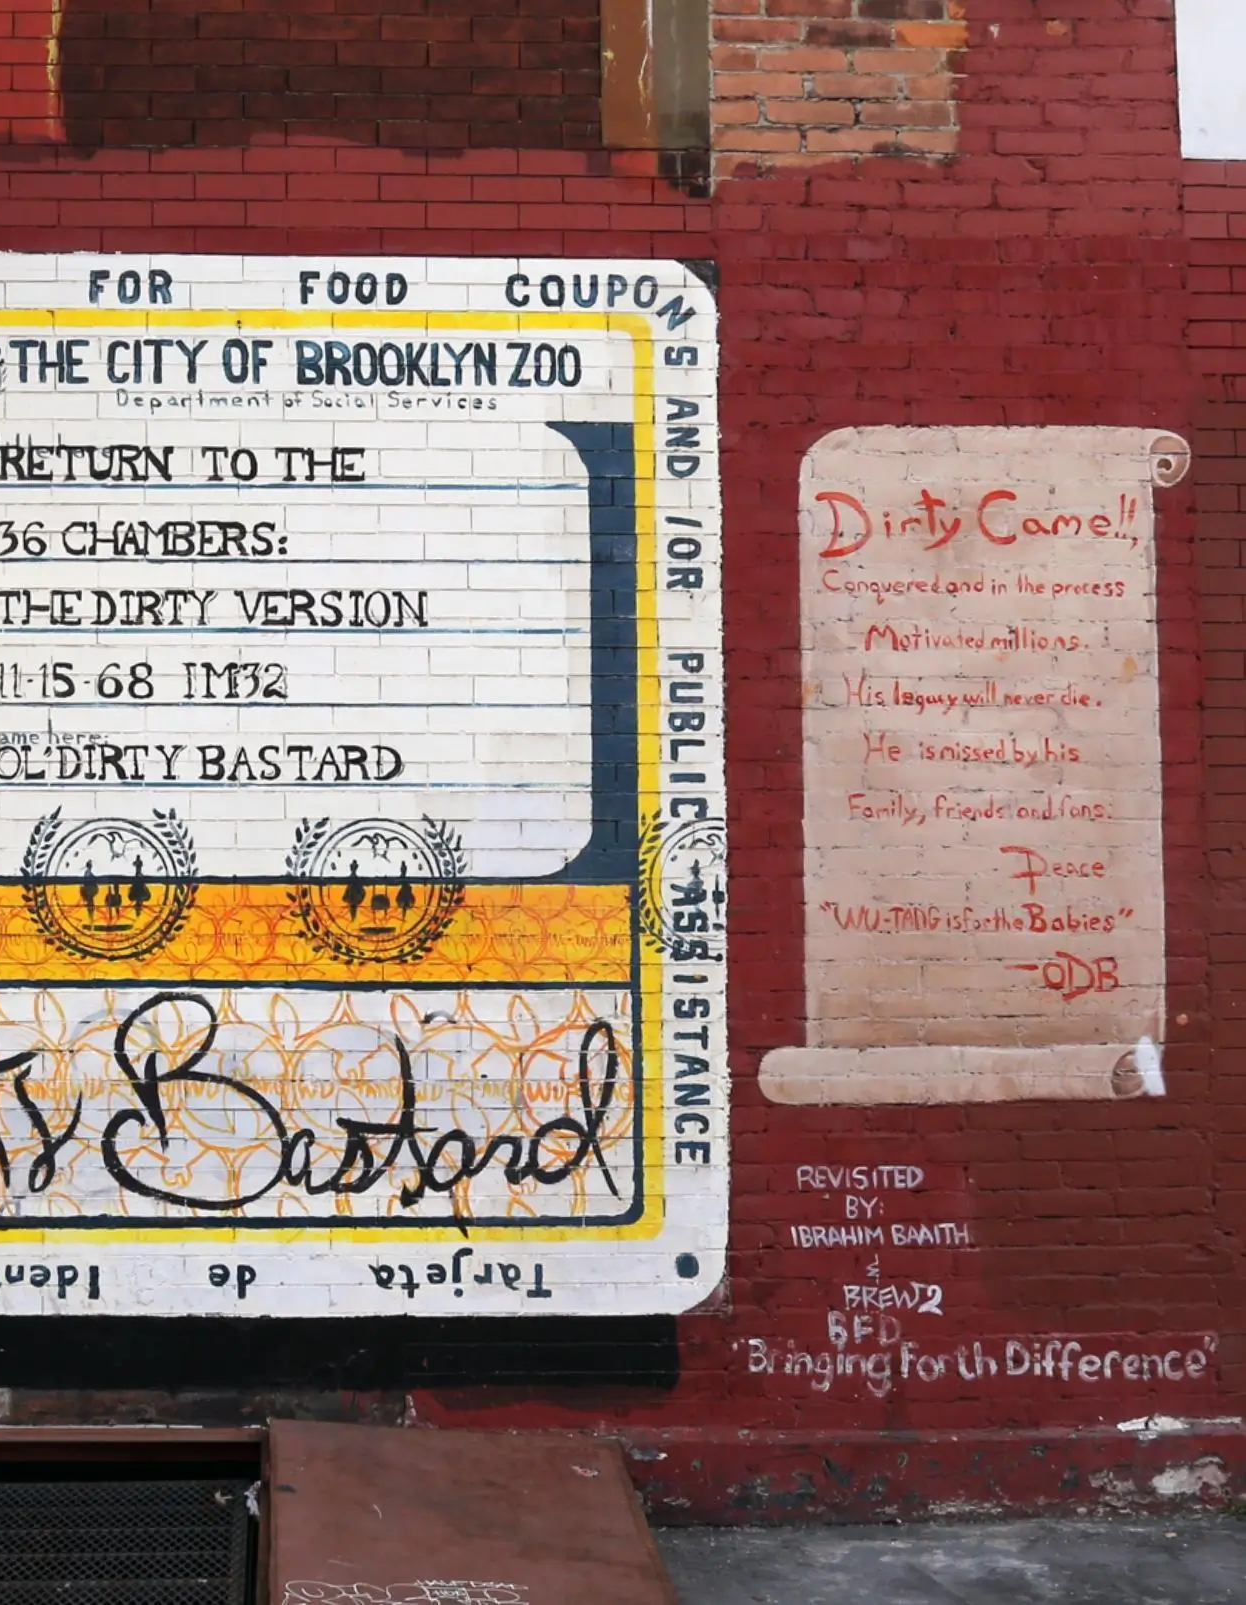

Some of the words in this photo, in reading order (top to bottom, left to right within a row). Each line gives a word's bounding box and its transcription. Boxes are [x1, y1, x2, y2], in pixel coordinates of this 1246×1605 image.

[88, 270, 173, 304] FOR
[299, 271, 409, 304] FOOD
[9, 339, 90, 384] THE
[107, 339, 209, 384] CITY
[222, 338, 274, 384] OF
[295, 340, 498, 387] BROOKLYN
[506, 342, 583, 387] ZOO
[115, 389, 272, 414] Department
[284, 390, 302, 408] of
[312, 389, 375, 408] Social
[388, 389, 498, 410] Services
[665, 397, 701, 479] AND
[202, 446, 257, 481] TO
[275, 446, 366, 482] THE
[61, 520, 288, 557] CHAMBERS:
[815, 488, 962, 559] Dirty
[945, 573, 985, 595] and
[991, 578, 1008, 595] in
[1018, 572, 1046, 595] the
[1052, 579, 1126, 602] process
[91, 589, 220, 627] DIRTY
[235, 589, 429, 628] VERSION
[864, 624, 985, 652] Motivated
[990, 625, 1090, 652] millions.
[843, 671, 885, 707] His
[963, 680, 997, 705] will
[1004, 690, 1054, 706] never
[667, 652, 708, 820] PUBLIC
[863, 731, 902, 764] He
[1012, 739, 1040, 769] by
[1044, 737, 1081, 763] his
[197, 744, 404, 781] BASTARD
[935, 794, 1005, 821] friends
[1016, 795, 1054, 821] and
[999, 846, 1106, 896] Peace
[670, 882, 711, 1165] ASSISTANCE
[797, 1165, 924, 1191] REVISITED
[845, 1195, 886, 1219] BY:
[790, 1223, 885, 1248] IBRAHIM
[891, 1221, 971, 1247] BAAITH
[208, 1262, 257, 1299] de
[368, 1247, 552, 1298] Tarjeta
[900, 1340, 998, 1382] Forth
